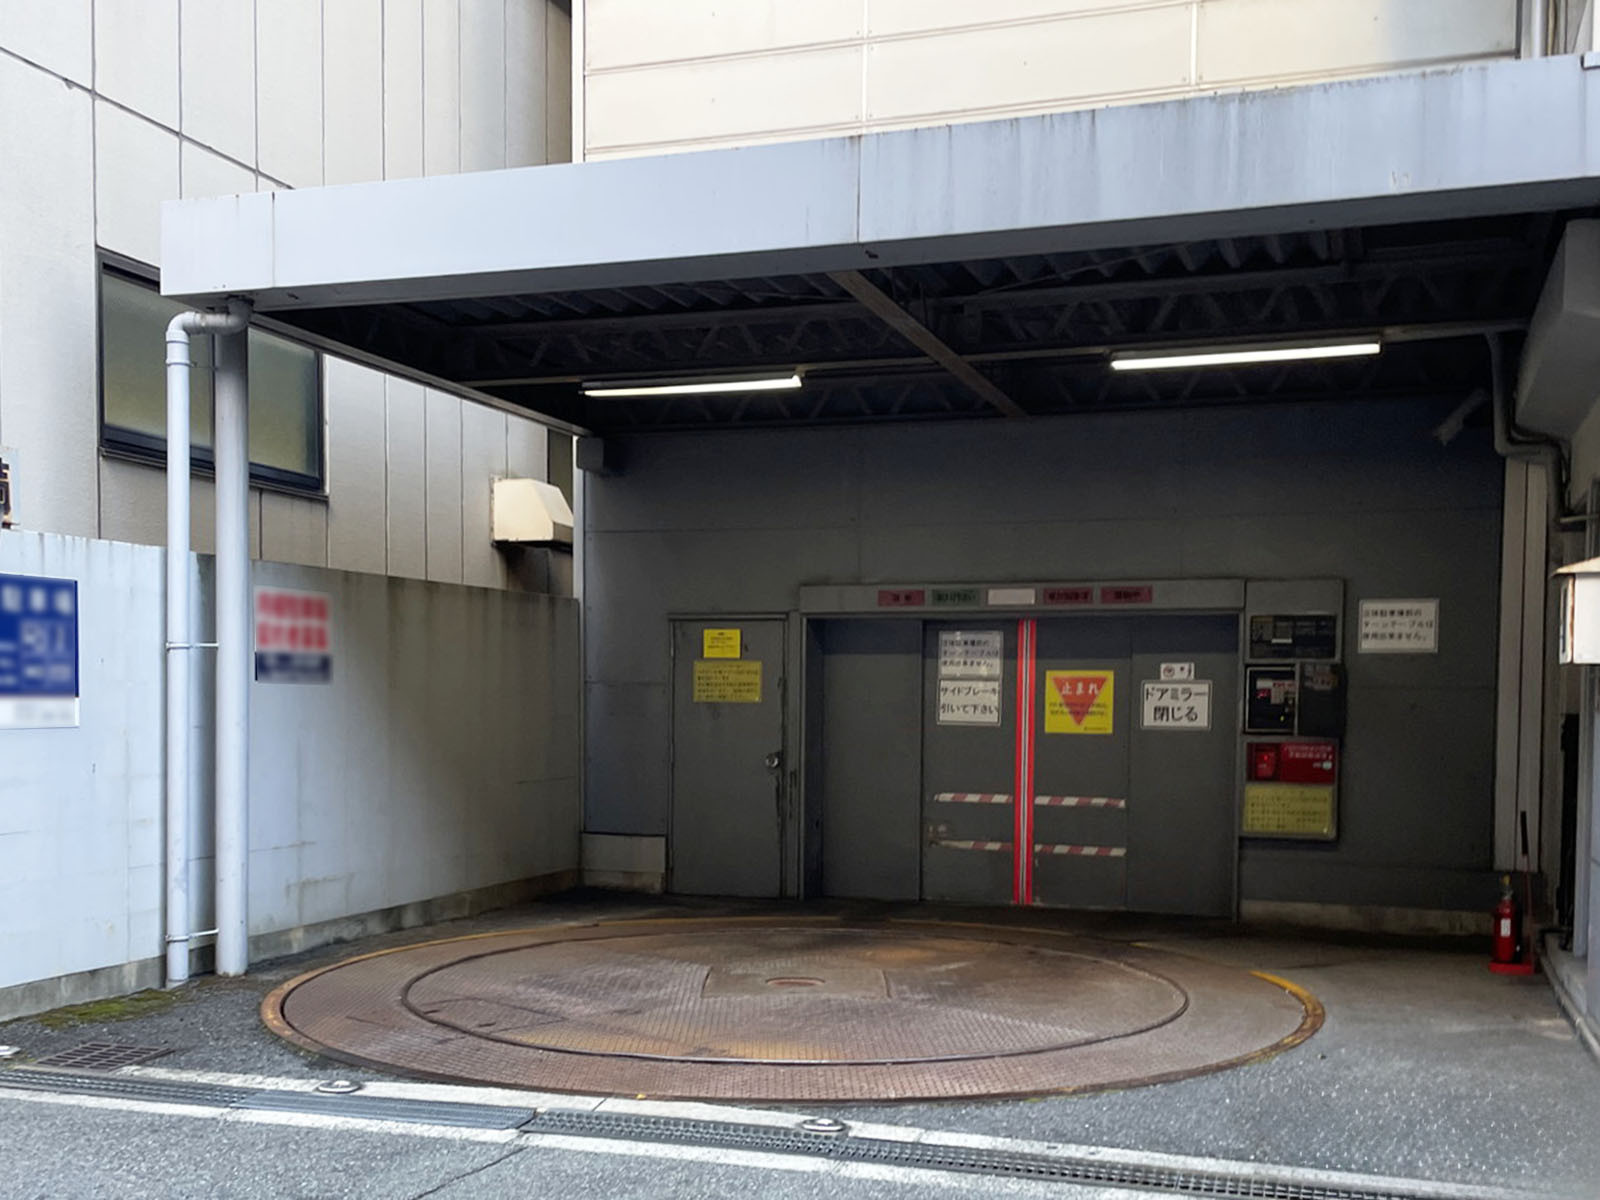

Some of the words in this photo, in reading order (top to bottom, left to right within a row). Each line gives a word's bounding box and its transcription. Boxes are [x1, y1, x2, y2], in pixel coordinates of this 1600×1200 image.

[1061, 681, 1099, 696] 止まれ
[1146, 687, 1208, 702] ドアミラー
[941, 703, 999, 716] 引いて下さい
[1154, 705, 1198, 722] 閉じる
